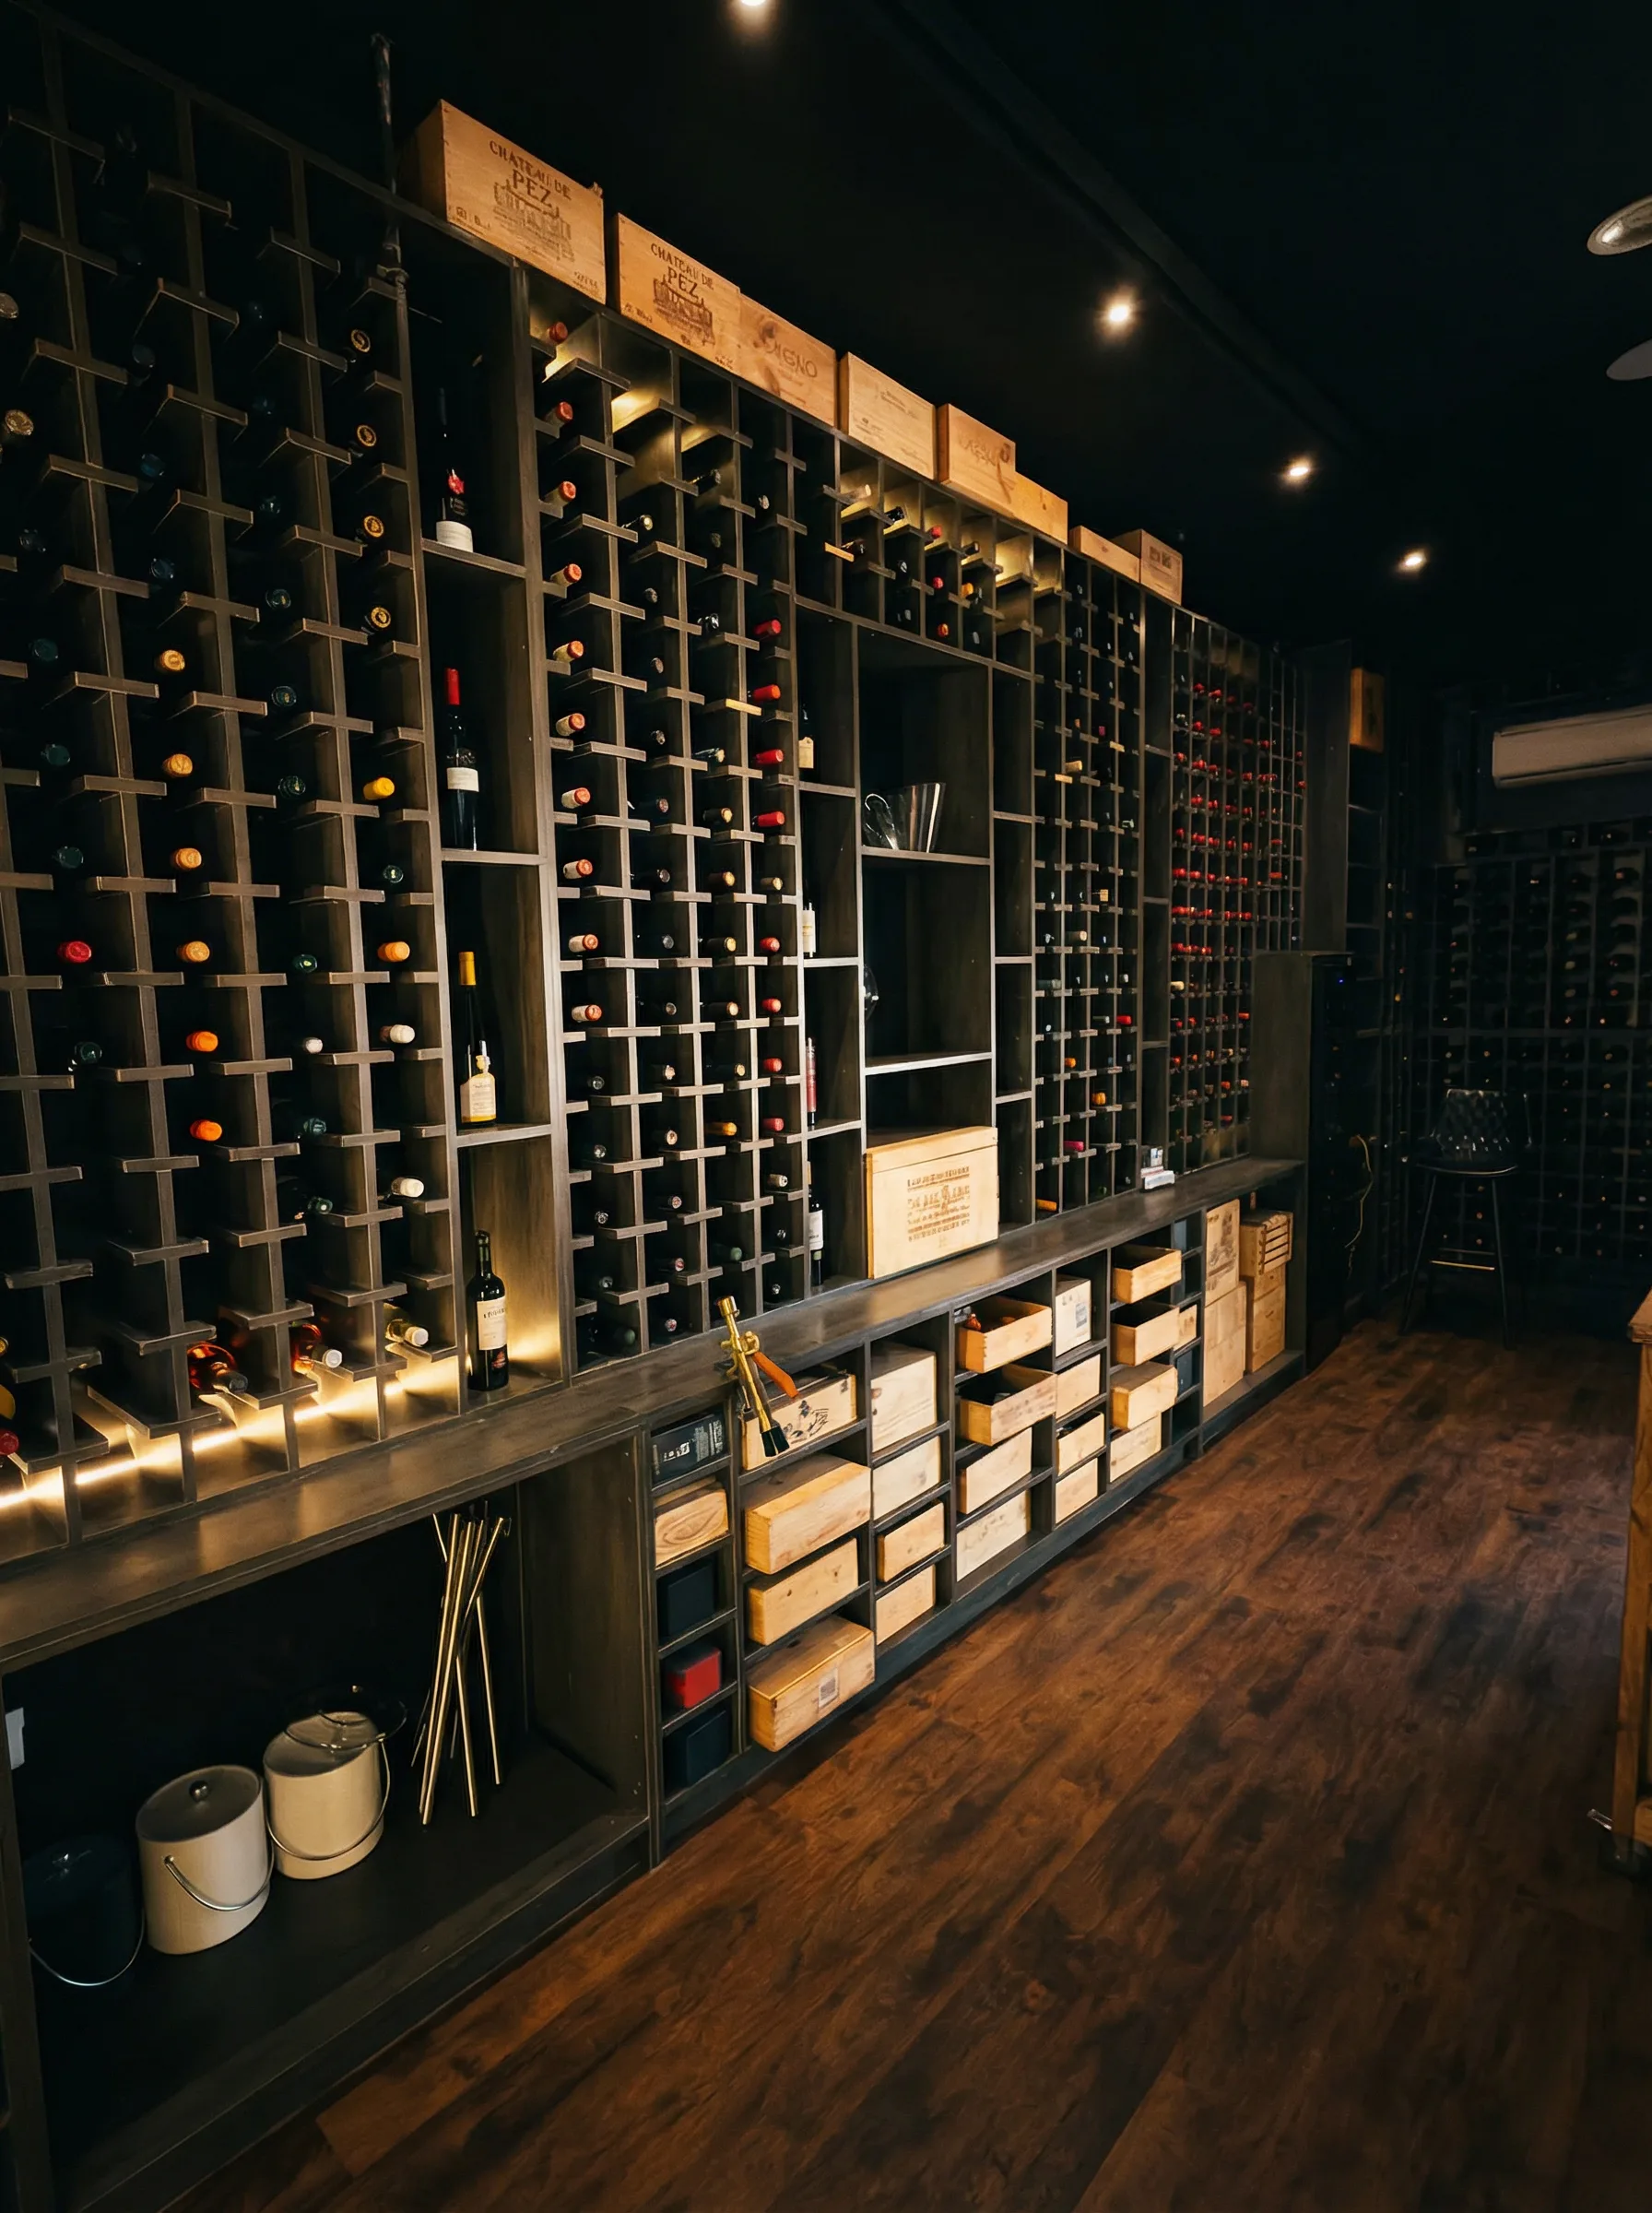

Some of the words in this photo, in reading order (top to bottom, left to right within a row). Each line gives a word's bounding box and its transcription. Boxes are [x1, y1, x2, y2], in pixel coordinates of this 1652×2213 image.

[512, 168, 553, 208] PEZ
[554, 179, 572, 201] DE
[667, 266, 700, 302] PEZ
